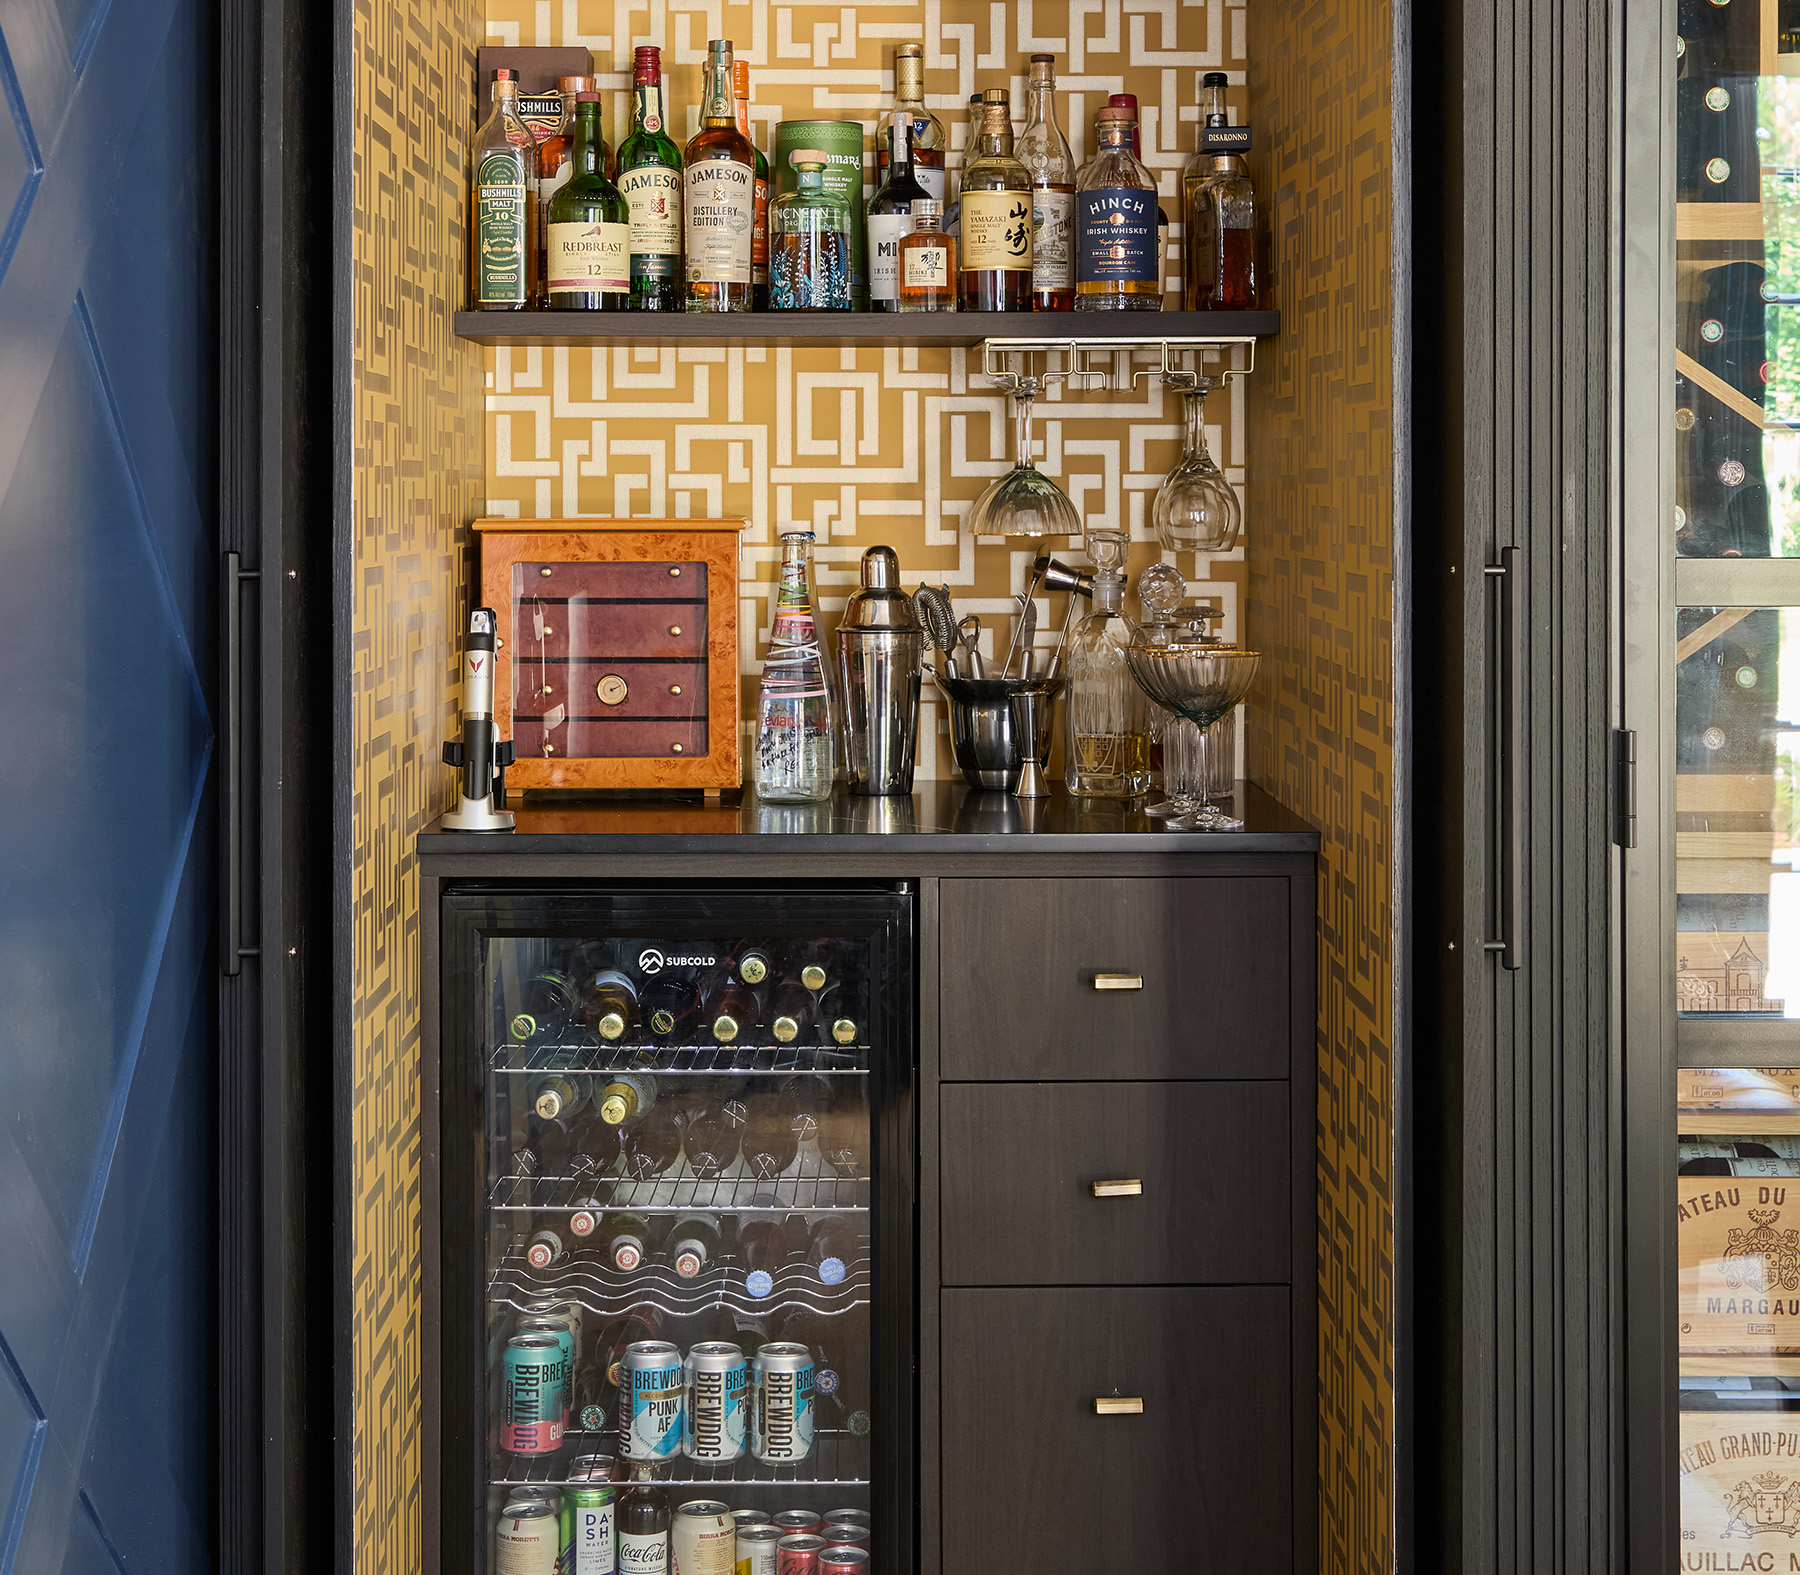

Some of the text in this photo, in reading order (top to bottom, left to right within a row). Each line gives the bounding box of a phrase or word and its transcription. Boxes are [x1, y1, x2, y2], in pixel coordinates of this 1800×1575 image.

[914, 122, 923, 130] 12
[1208, 133, 1248, 142] DISARONNO
[691, 168, 748, 186] JAMESON
[481, 188, 522, 198] BUSHMILLS
[492, 200, 512, 208] MALT
[1089, 197, 1144, 215] HINCH
[494, 211, 509, 221] 10
[693, 206, 738, 216] DISTILLERY
[693, 217, 724, 226] EDITION
[970, 216, 1007, 224] YAMAZAKI
[1004, 201, 1030, 256] 山崎
[1086, 228, 1108, 236] IRISH
[977, 234, 987, 244] 12
[563, 241, 624, 252] REDBREAST
[588, 264, 602, 276] 12
[666, 957, 716, 966] SUBCOLD
[1758, 1186, 1786, 1206] DU
[748, 1281, 770, 1290] Corona
[1707, 1297, 1800, 1316] MARGAU
[513, 1364, 540, 1450] BREWDOG
[649, 1398, 678, 1416] PUNK
[696, 1372, 722, 1457] BREWDOG
[767, 1372, 792, 1458] BREWDOG
[657, 1416, 672, 1432] AF
[639, 1436, 653, 1448] BETTER
[699, 1532, 718, 1540] BIRRA
[586, 1540, 608, 1548] WATER
[621, 1541, 666, 1563] Coca-Cola
